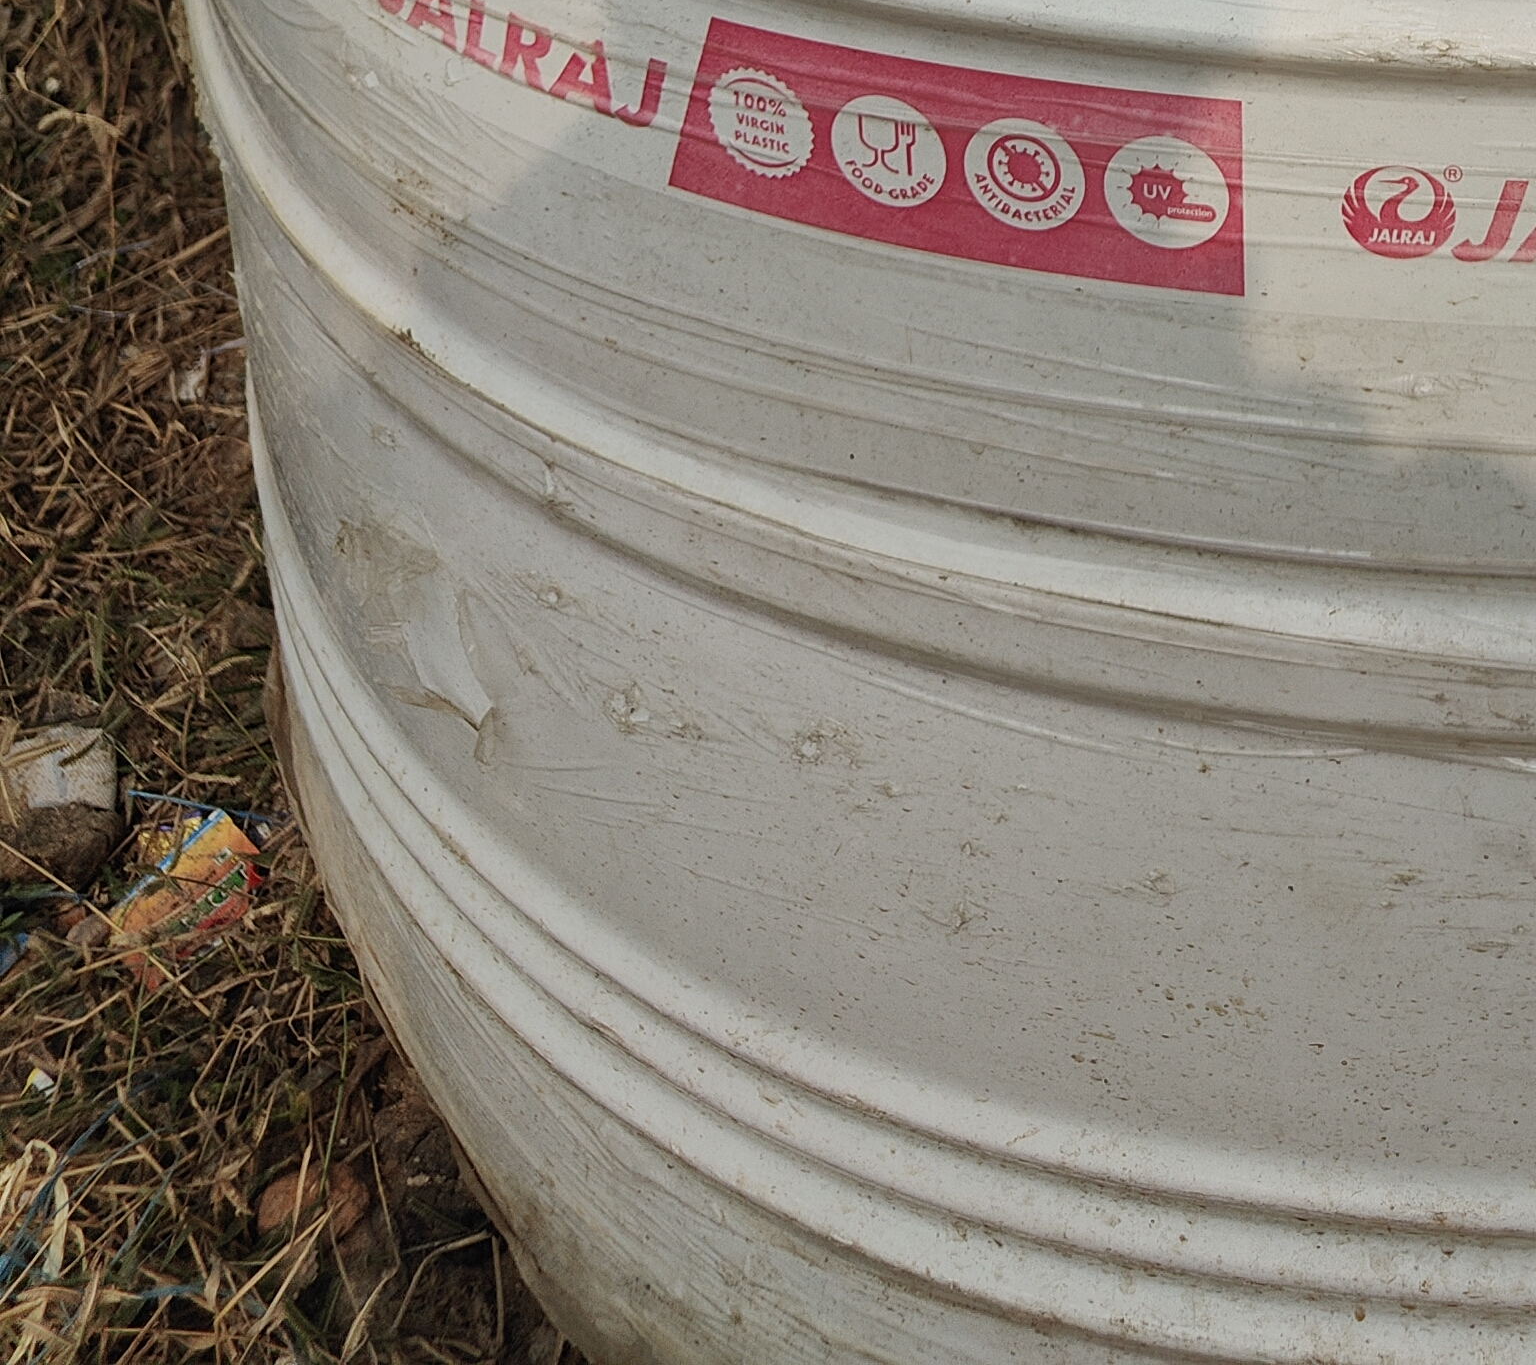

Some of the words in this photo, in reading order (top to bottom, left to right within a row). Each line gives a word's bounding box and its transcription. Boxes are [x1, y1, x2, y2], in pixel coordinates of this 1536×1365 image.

[733, 90, 787, 117] 100%
[735, 112, 785, 135] VIRGIN
[734, 130, 790, 154] PLASTIC
[846, 160, 884, 197] FOOD
[888, 173, 935, 202] GRADE
[1143, 183, 1172, 200] UV
[973, 172, 1077, 224] ANTIBACTERIAL
[1368, 228, 1436, 246] JALRAJ
